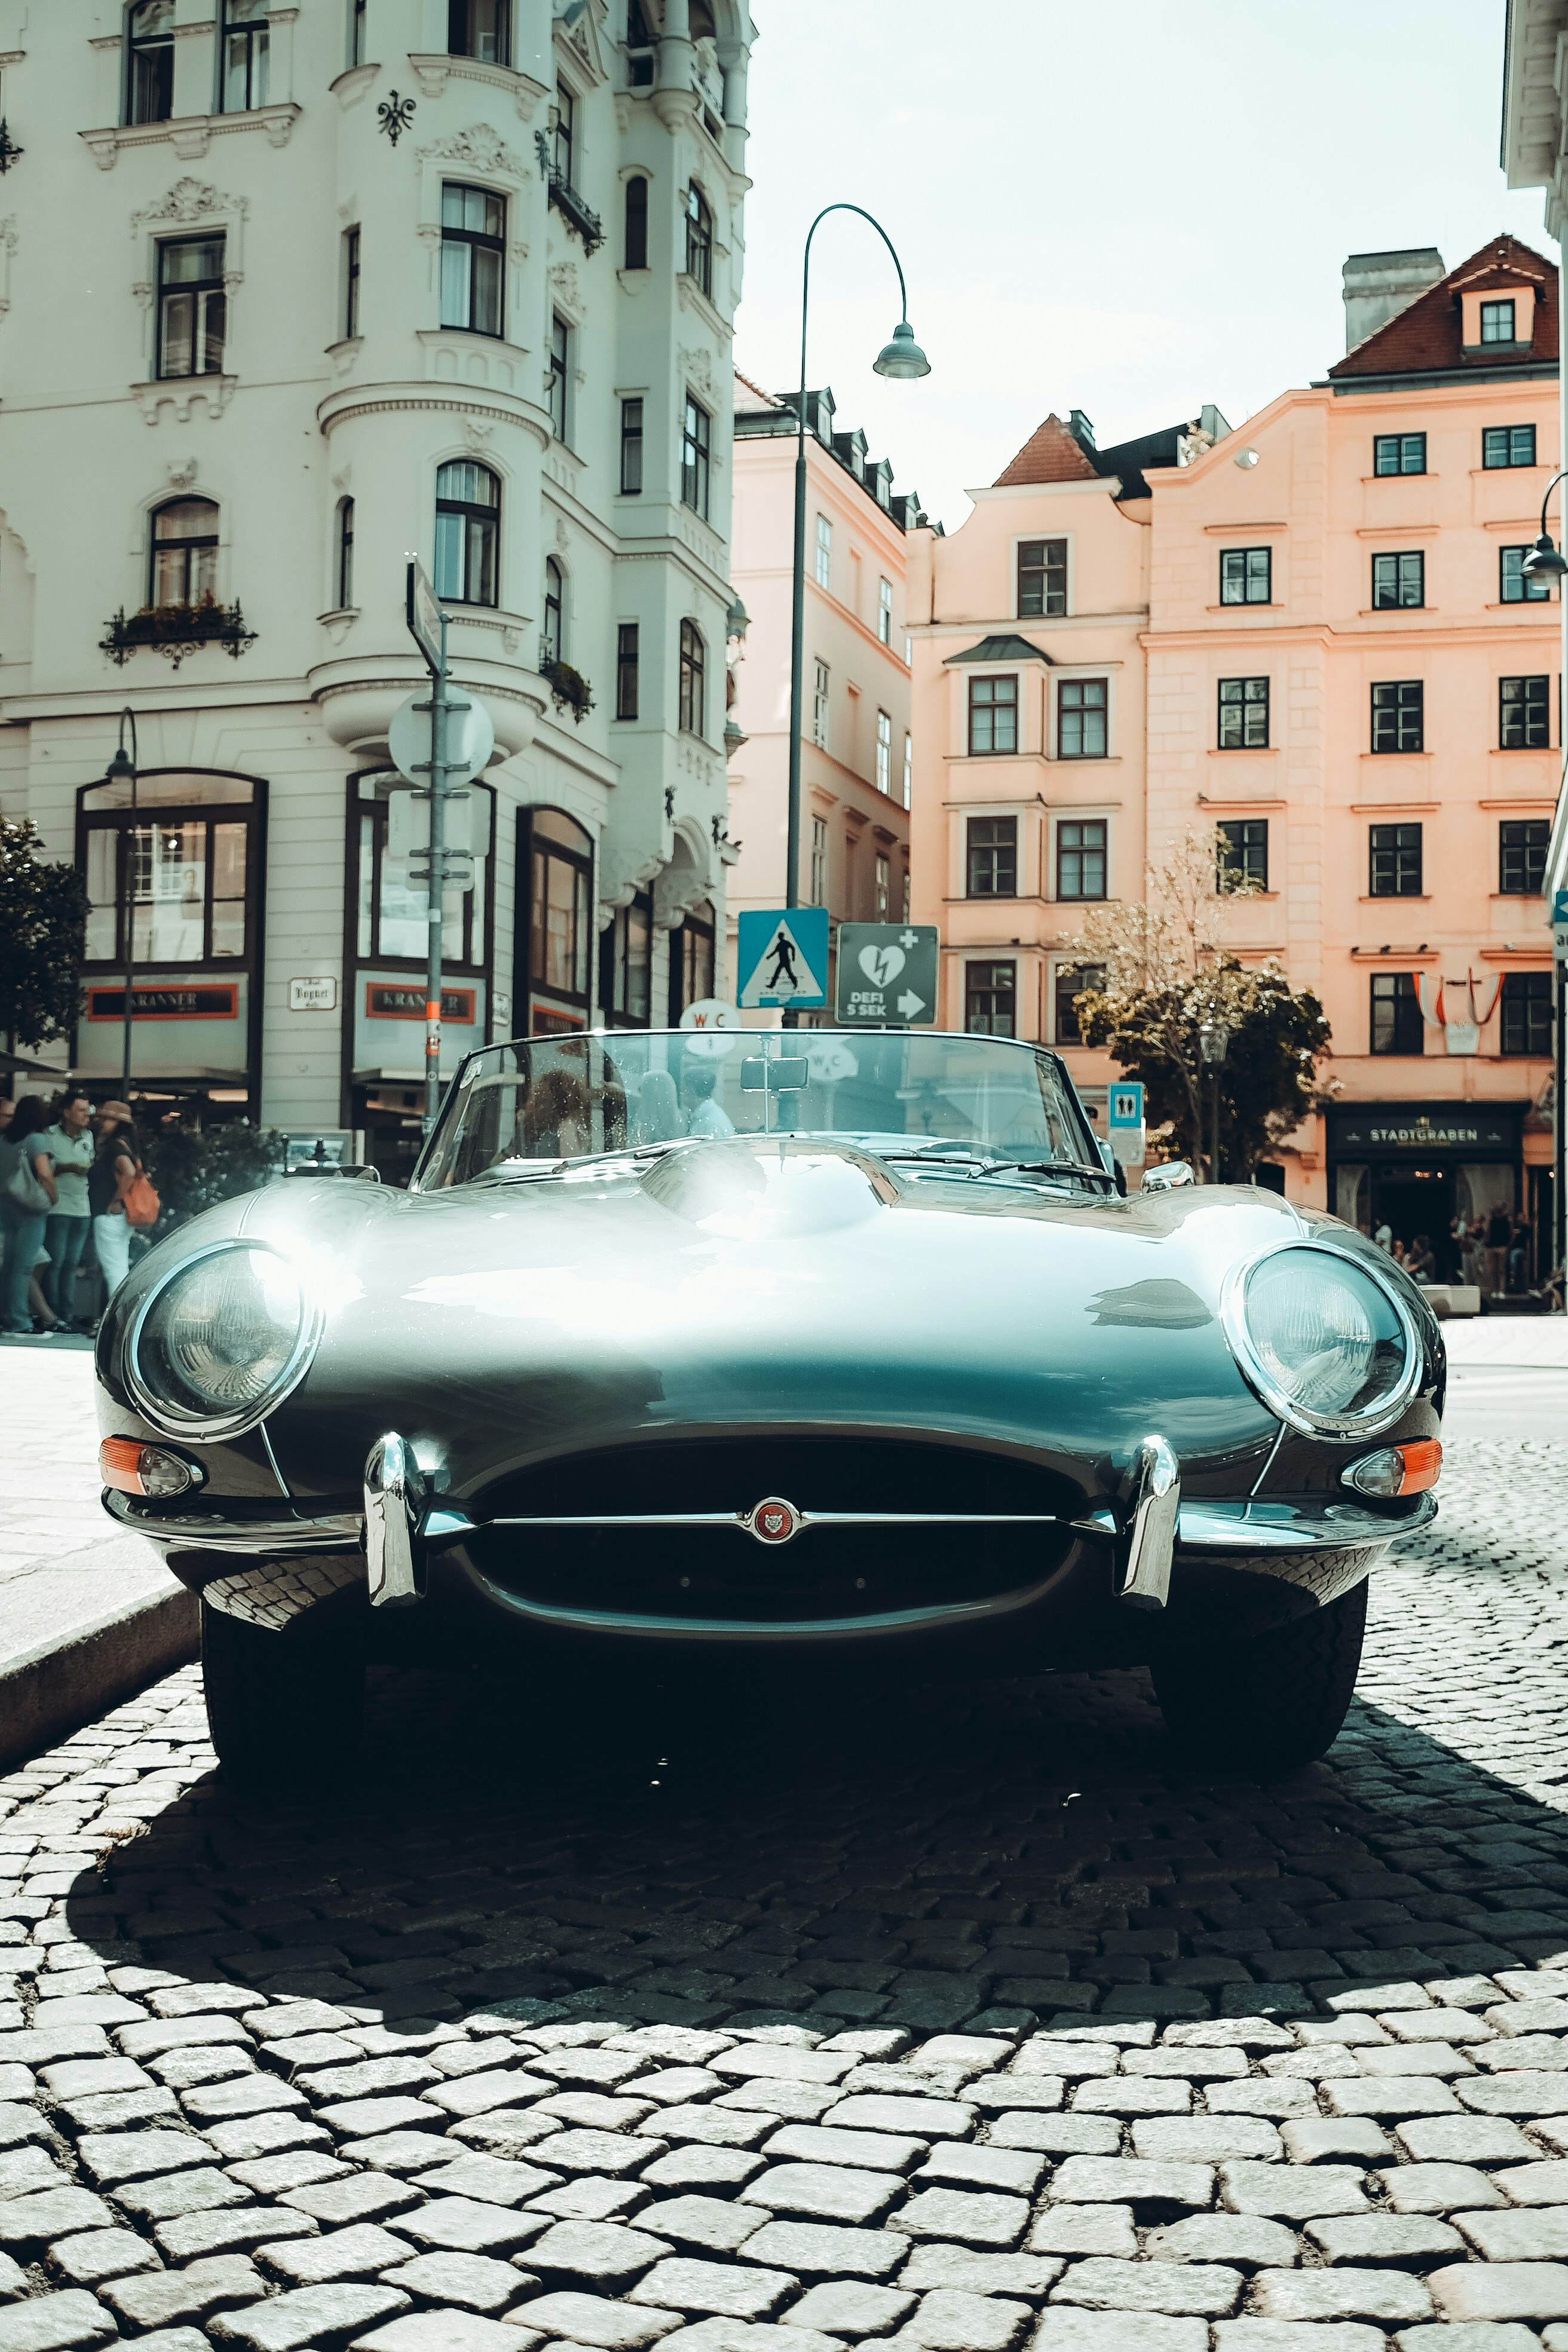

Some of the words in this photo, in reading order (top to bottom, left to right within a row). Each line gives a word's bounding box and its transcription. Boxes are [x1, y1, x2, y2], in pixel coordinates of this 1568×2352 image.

[127, 992, 197, 1007] RANNER
[383, 992, 458, 1009] KRANR
[850, 991, 884, 1004] DEFI
[846, 1003, 856, 1016] 5
[858, 1004, 887, 1016] SEK
[1370, 1129, 1477, 1142] STADTGRABEN
